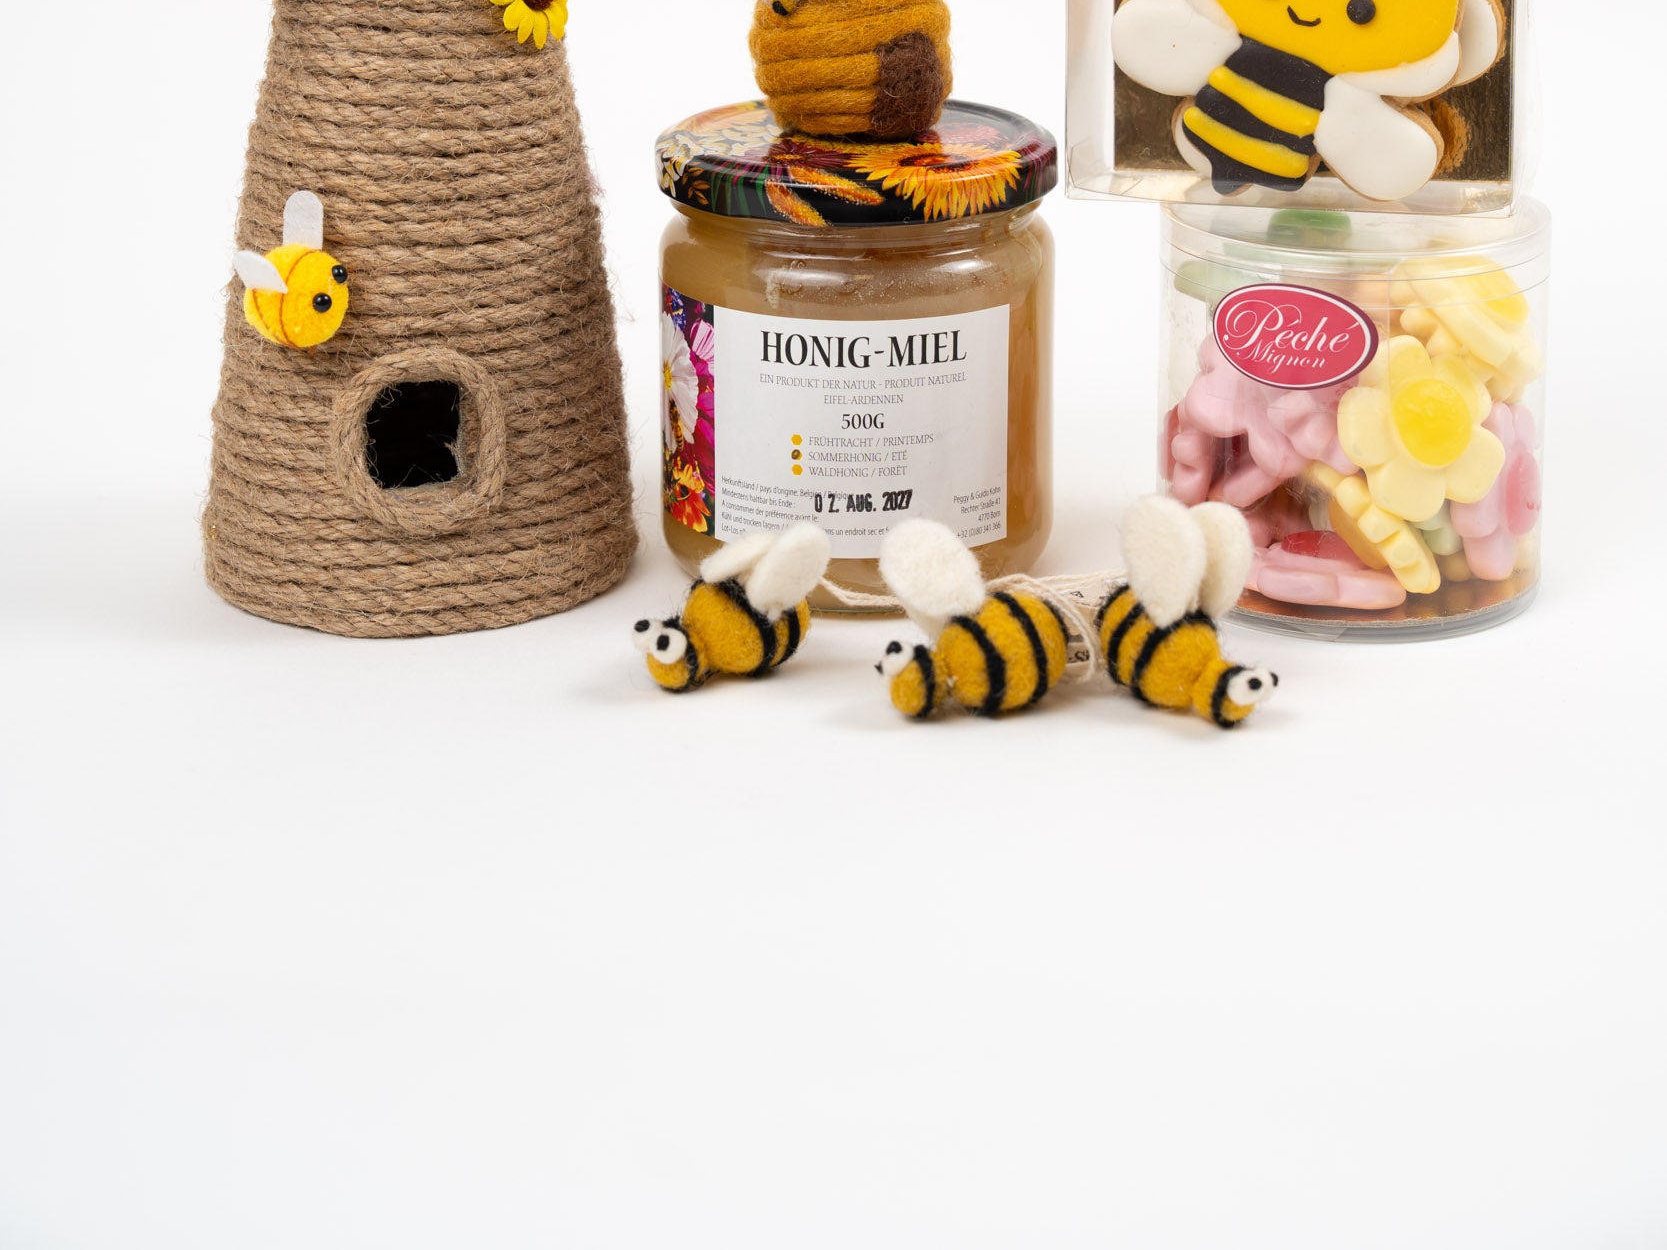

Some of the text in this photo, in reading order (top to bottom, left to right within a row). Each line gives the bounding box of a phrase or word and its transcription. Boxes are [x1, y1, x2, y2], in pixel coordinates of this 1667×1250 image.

[1223, 299, 1359, 353] Péché
[760, 329, 967, 368] HONIG-MIEL
[1236, 339, 1327, 374] Mignon
[759, 373, 775, 384] EIN
[776, 375, 819, 389] PRODUKT
[822, 379, 841, 390] DER
[843, 379, 877, 390] NATUR
[884, 377, 926, 389] PRODUIT
[928, 372, 967, 387] NATUREL
[823, 394, 905, 405] EIFEL-ARDENNEN
[841, 413, 885, 430] 500G
[808, 436, 873, 448] FRÜHTRACHT
[883, 433, 935, 447] PRINTEMPS
[808, 451, 882, 463] SOMMERHONIG
[808, 466, 869, 478] WALDHONIG
[878, 465, 908, 476] FORÊT
[721, 475, 755, 490] Herkunftsland
[760, 485, 772, 494] pays
[721, 487, 749, 501] Mindestens
[749, 495, 768, 504] haltbar
[769, 498, 778, 506] bis
[846, 493, 877, 512] AUG.
[882, 489, 913, 511] 2027
[726, 502, 755, 513] consommer
[765, 509, 794, 520] préférence
[733, 515, 743, 523] und
[743, 517, 762, 527] trocken
[844, 527, 866, 536] endroit
